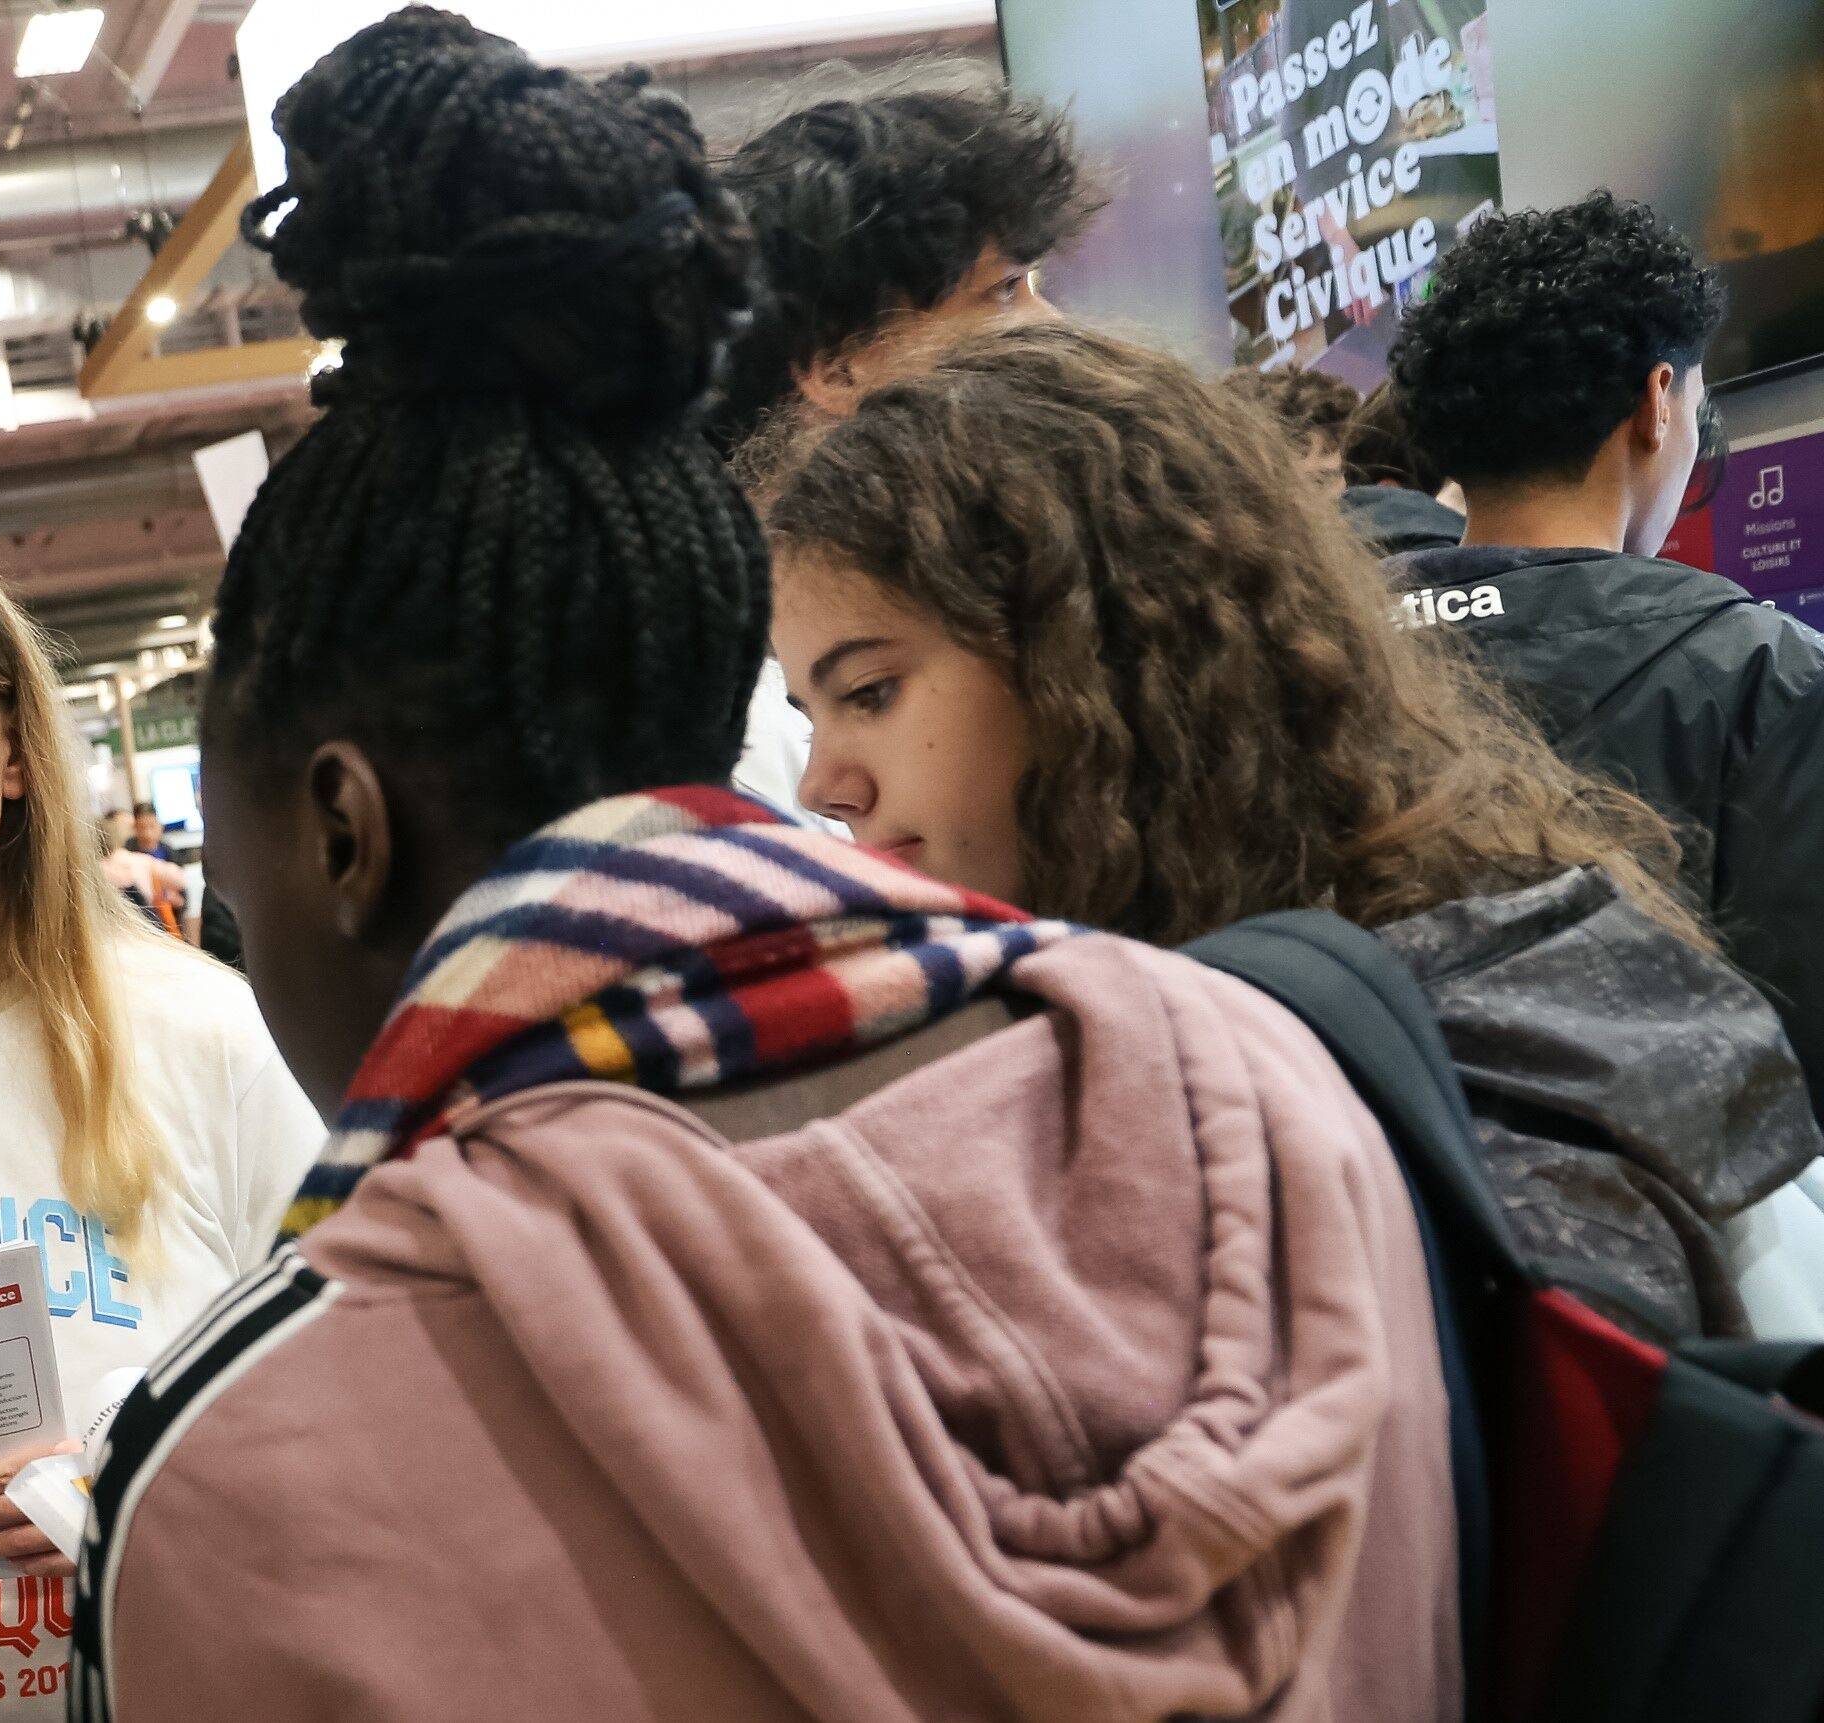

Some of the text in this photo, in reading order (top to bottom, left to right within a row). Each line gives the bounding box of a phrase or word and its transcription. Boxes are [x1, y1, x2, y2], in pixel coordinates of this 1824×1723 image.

[1231, 0, 1378, 136] Passez
[1241, 140, 1298, 205] en
[1253, 142, 1422, 274] Service
[1266, 216, 1438, 342] Civique
